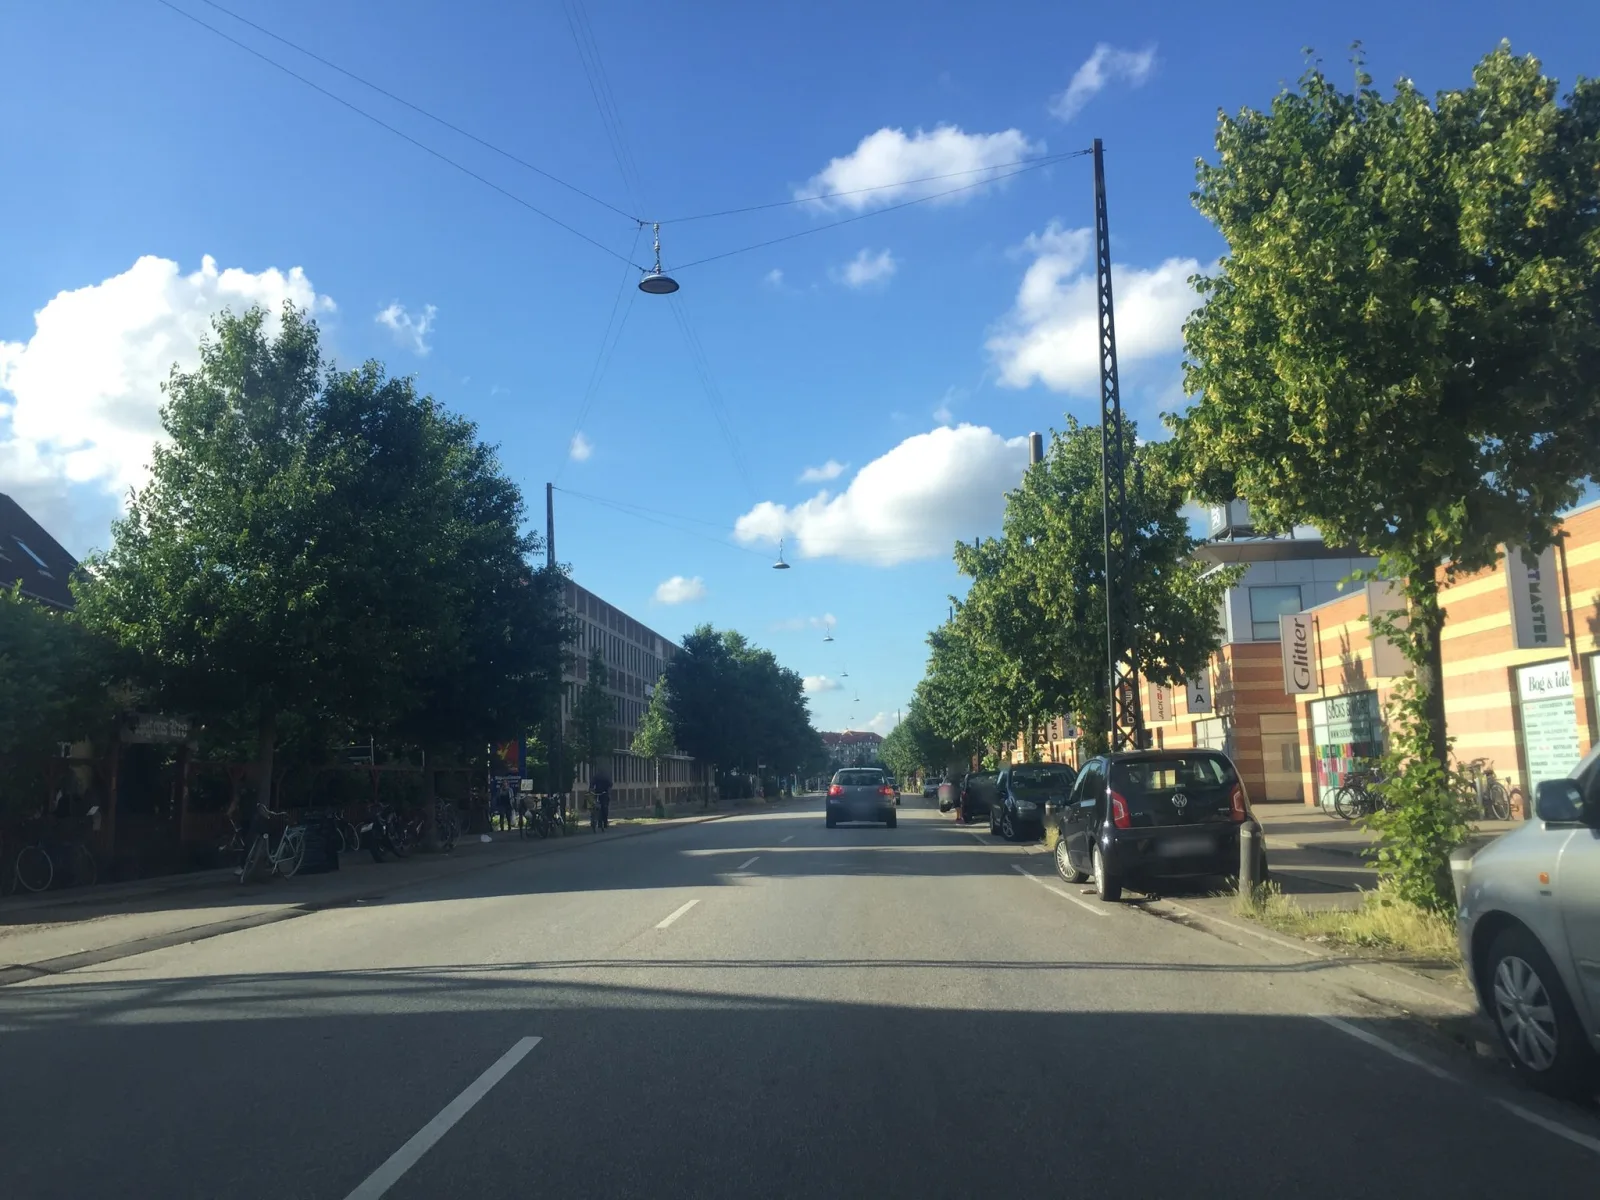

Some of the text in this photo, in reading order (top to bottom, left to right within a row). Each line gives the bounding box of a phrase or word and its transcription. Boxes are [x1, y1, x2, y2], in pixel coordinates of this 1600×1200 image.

[1527, 569, 1548, 644] TMASTER
[1292, 617, 1311, 690] Glitter
[1528, 670, 1570, 694] Bog & idé
[1328, 702, 1346, 719] SOCKS
